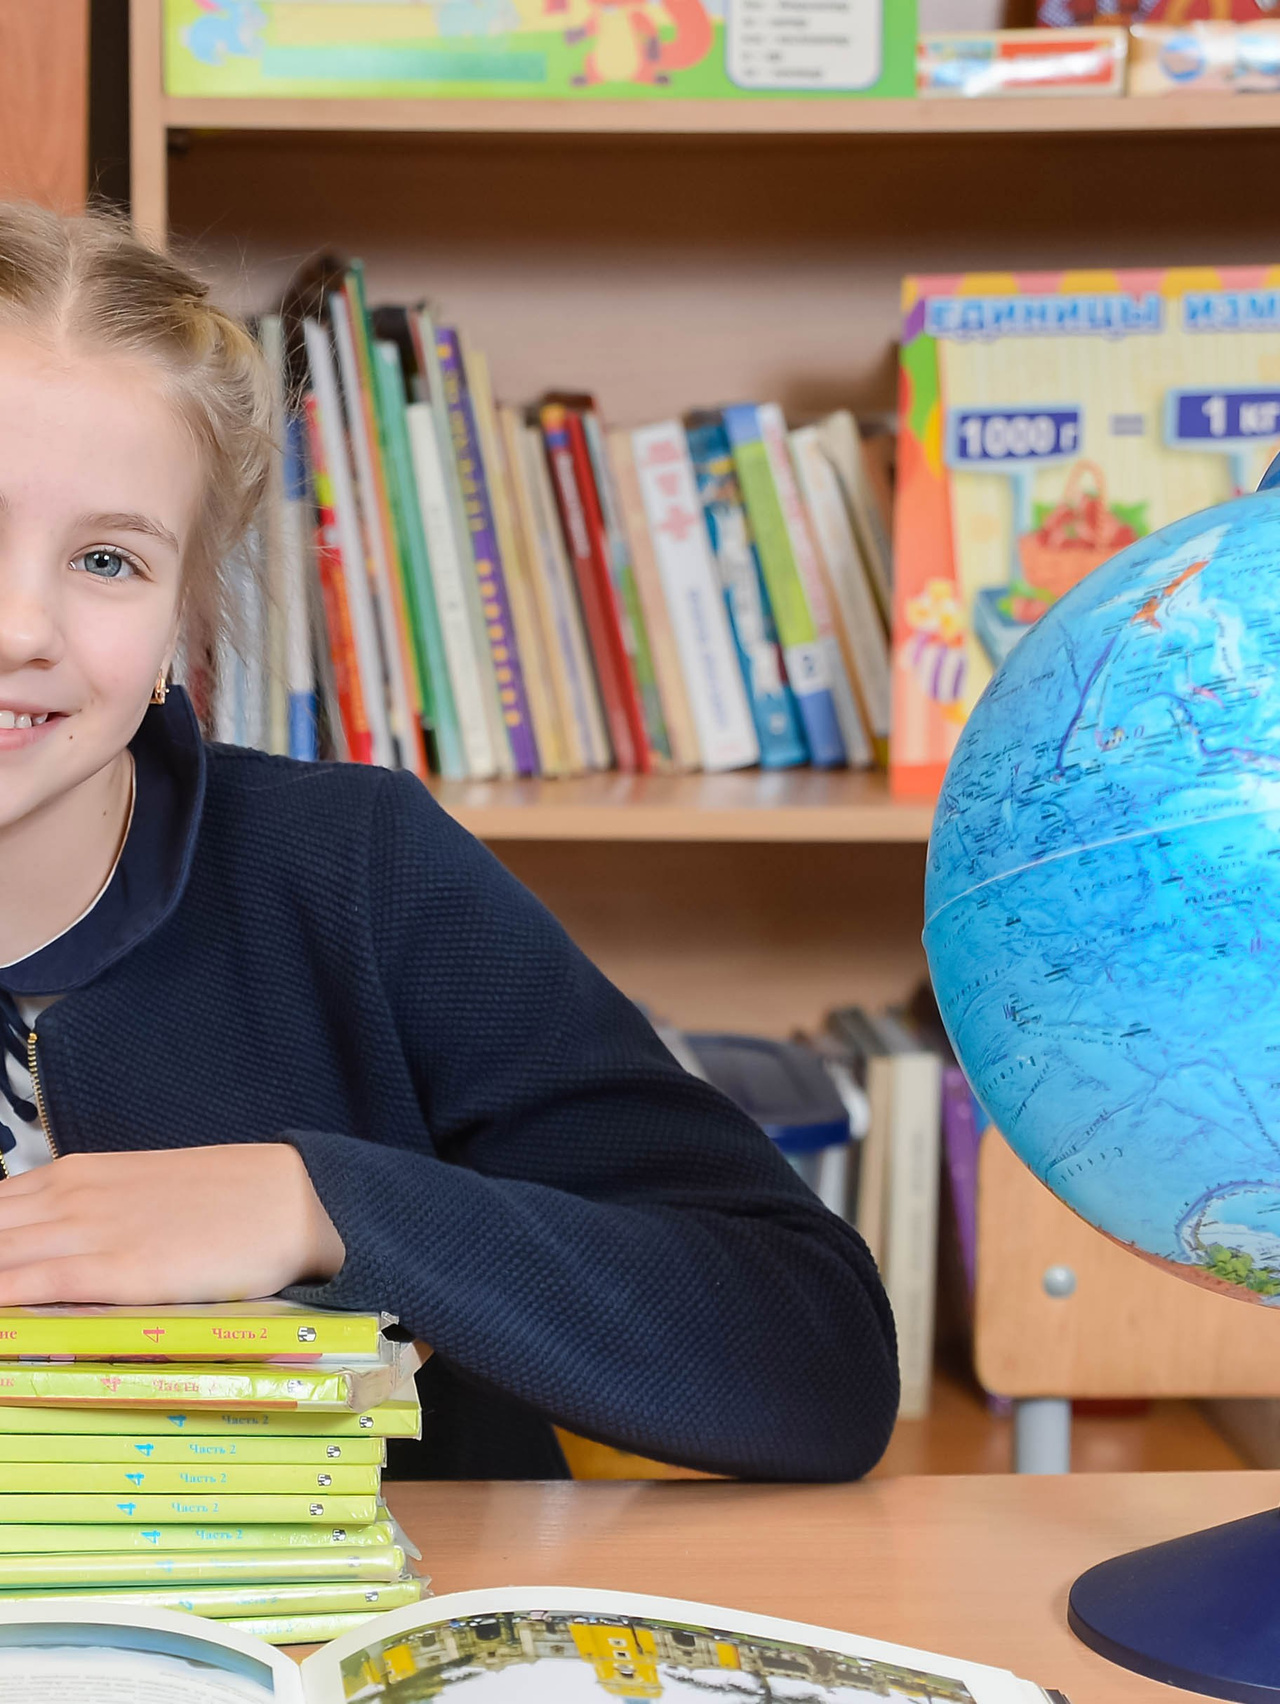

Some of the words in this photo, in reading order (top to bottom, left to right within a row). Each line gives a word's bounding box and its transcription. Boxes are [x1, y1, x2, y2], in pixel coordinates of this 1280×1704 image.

[928, 294, 1161, 334] ЕДИНИЦЫ
[960, 413, 1057, 457] 1000
[1201, 395, 1227, 437] 1
[143, 1327, 166, 1344] 4
[211, 1328, 256, 1340] Часть
[260, 1327, 268, 1340] 2
[152, 1378, 199, 1392] Часть
[222, 1415, 259, 1426] Часть
[263, 1414, 269, 1426] 2
[188, 1443, 229, 1456] Часть
[230, 1443, 237, 1455] 2
[180, 1472, 218, 1483] Часть
[220, 1472, 228, 1483] 2
[171, 1502, 209, 1514] Часть
[212, 1501, 219, 1513] 2
[195, 1528, 233, 1541] Часть
[236, 1528, 243, 1540] 2
